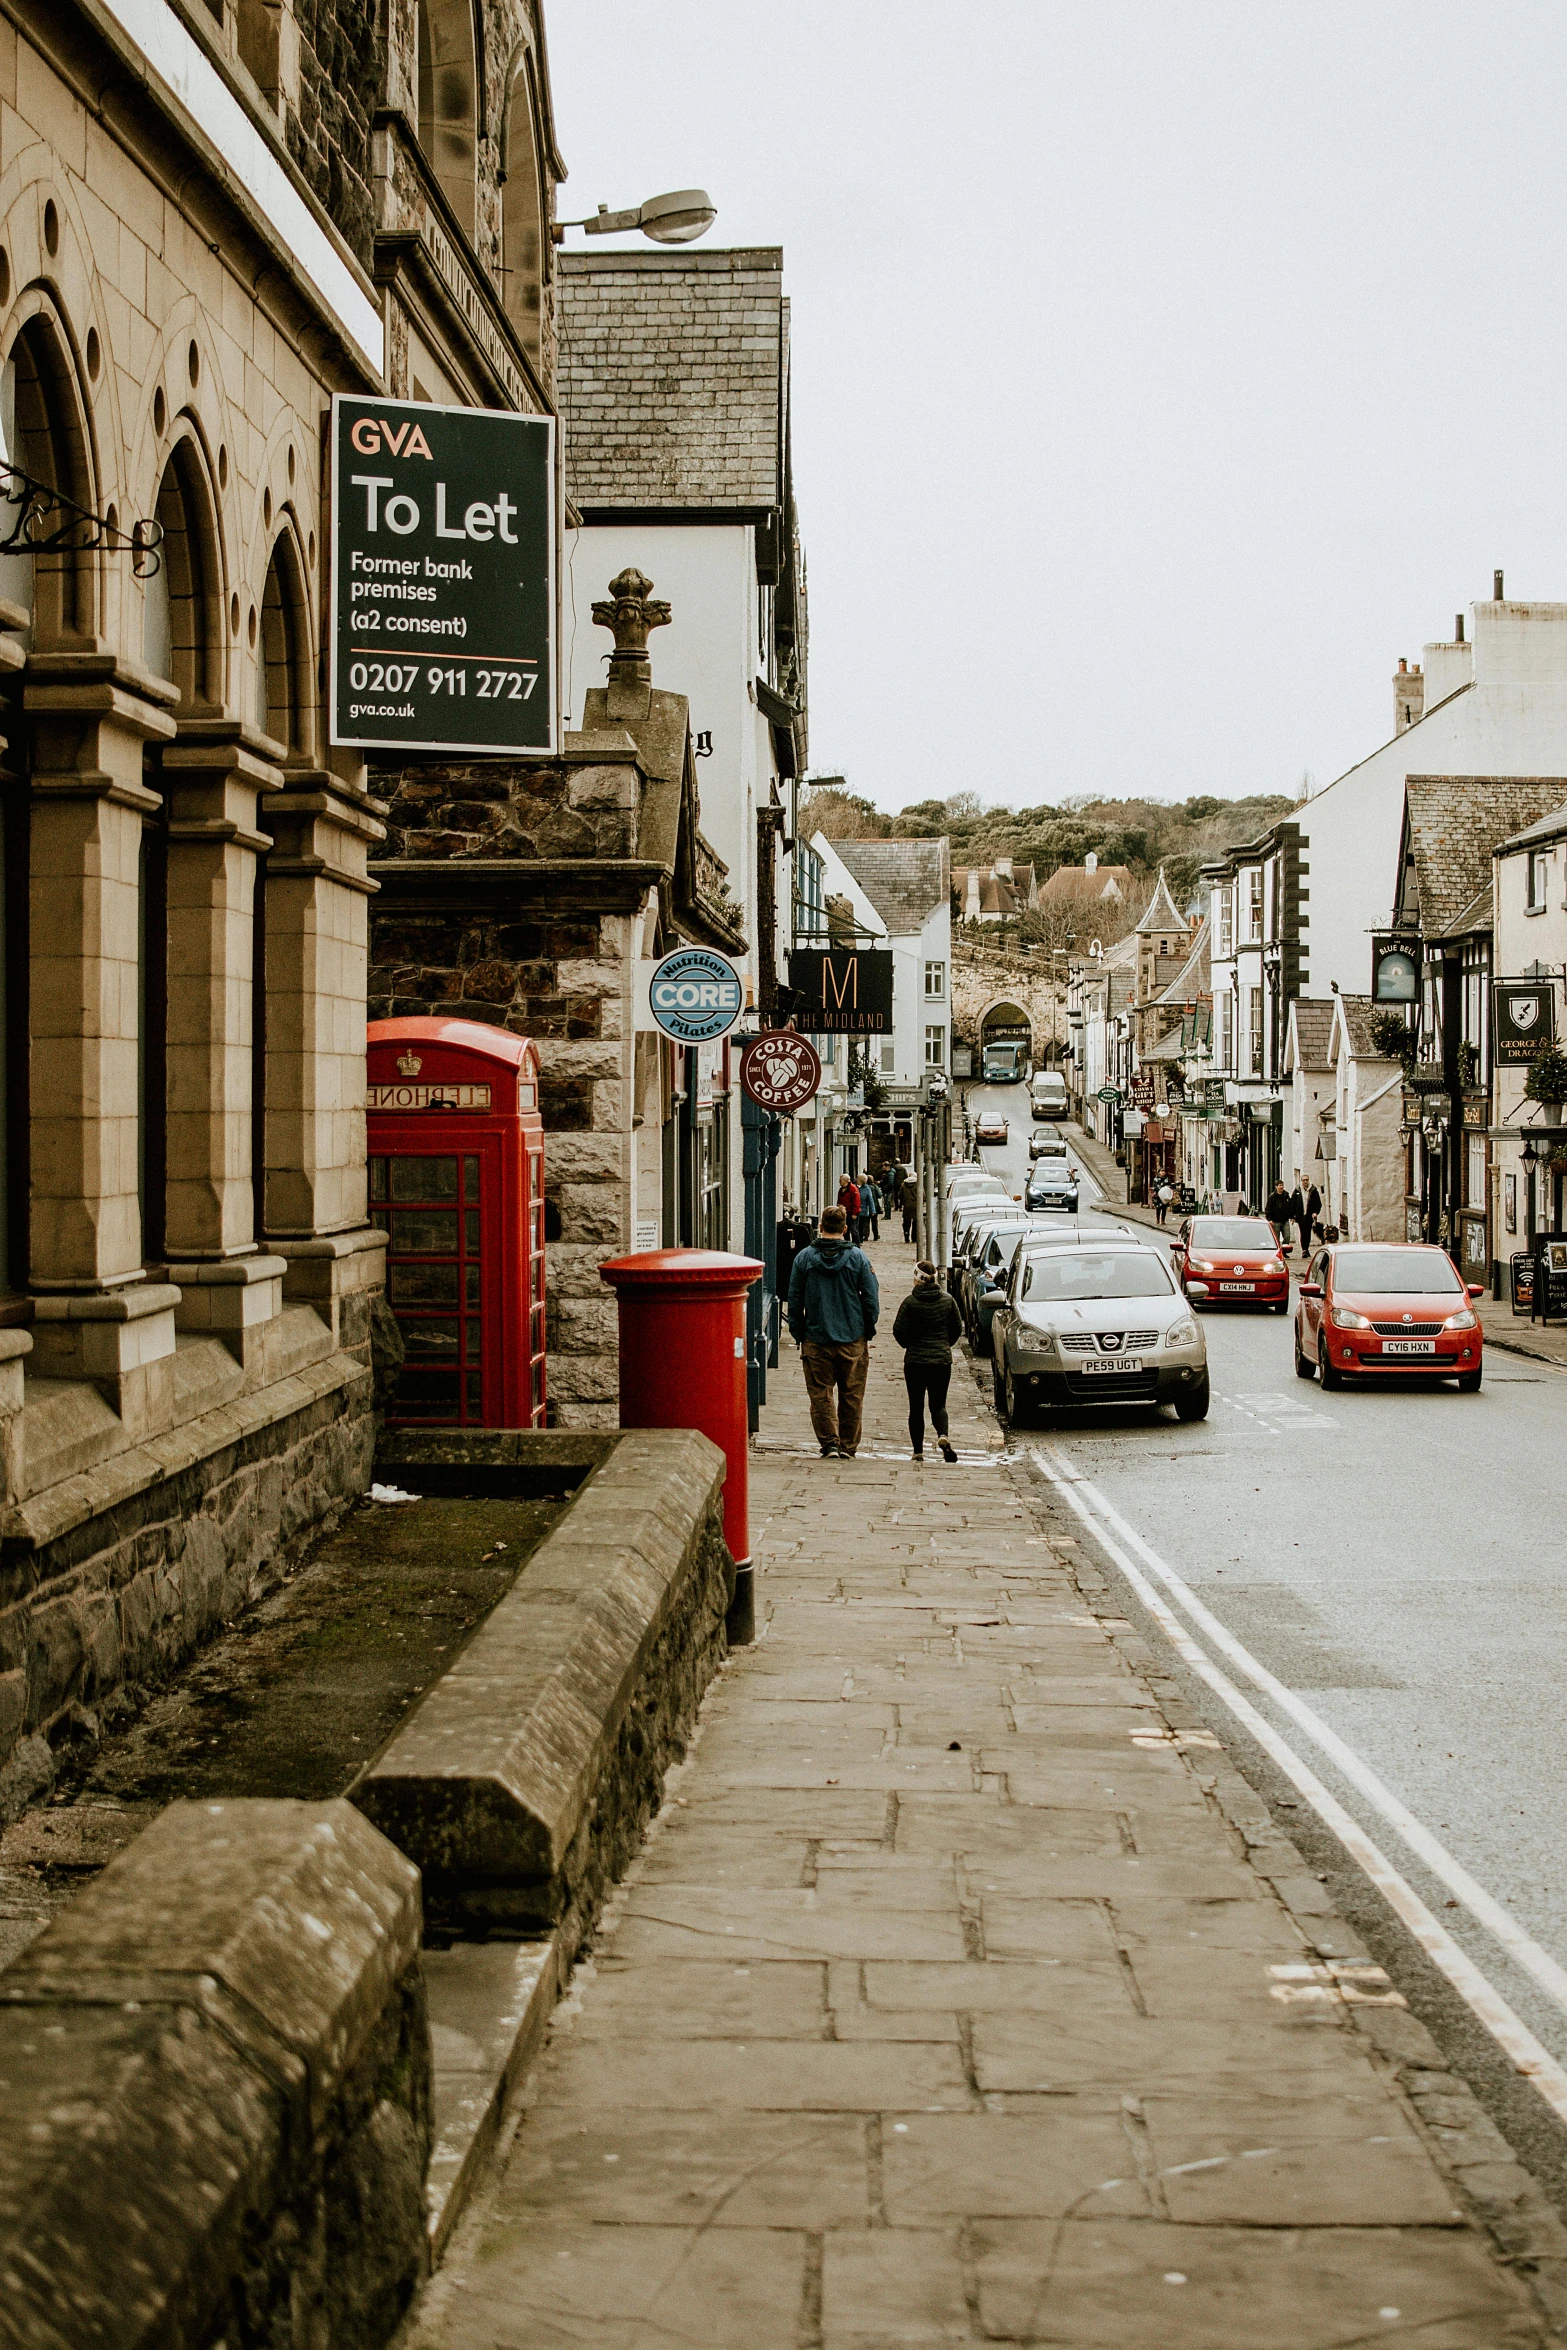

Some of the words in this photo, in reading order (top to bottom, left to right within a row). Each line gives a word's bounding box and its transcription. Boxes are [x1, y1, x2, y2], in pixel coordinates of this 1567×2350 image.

[352, 418, 434, 460] GVA
[352, 475, 420, 534] To
[436, 482, 518, 544] Let
[351, 551, 420, 576] Former
[425, 557, 473, 580] bank
[351, 579, 437, 602] premises
[351, 610, 380, 632] (a2
[386, 616, 467, 637] consent)
[350, 663, 419, 693] 0207
[428, 668, 466, 696] 911
[476, 671, 538, 700] 2727
[350, 703, 415, 718] gva.co.uk
[1379, 944, 1398, 955] BLUE
[1400, 944, 1416, 957] BELL
[662, 954, 726, 978] Nutrition
[823, 957, 858, 1009] M
[656, 984, 736, 1008] CORE
[670, 1018, 722, 1036] Pilates
[824, 1013, 884, 1028] MIDLAND
[756, 1040, 802, 1060] COSTA
[1500, 1040, 1538, 1048] GEORGE
[754, 1078, 810, 1102] COFFEE
[1388, 1343, 1408, 1351] CY16
[1411, 1342, 1429, 1351] HXN
[1086, 1360, 1114, 1371] PE59
[1117, 1360, 1137, 1370] UGT
